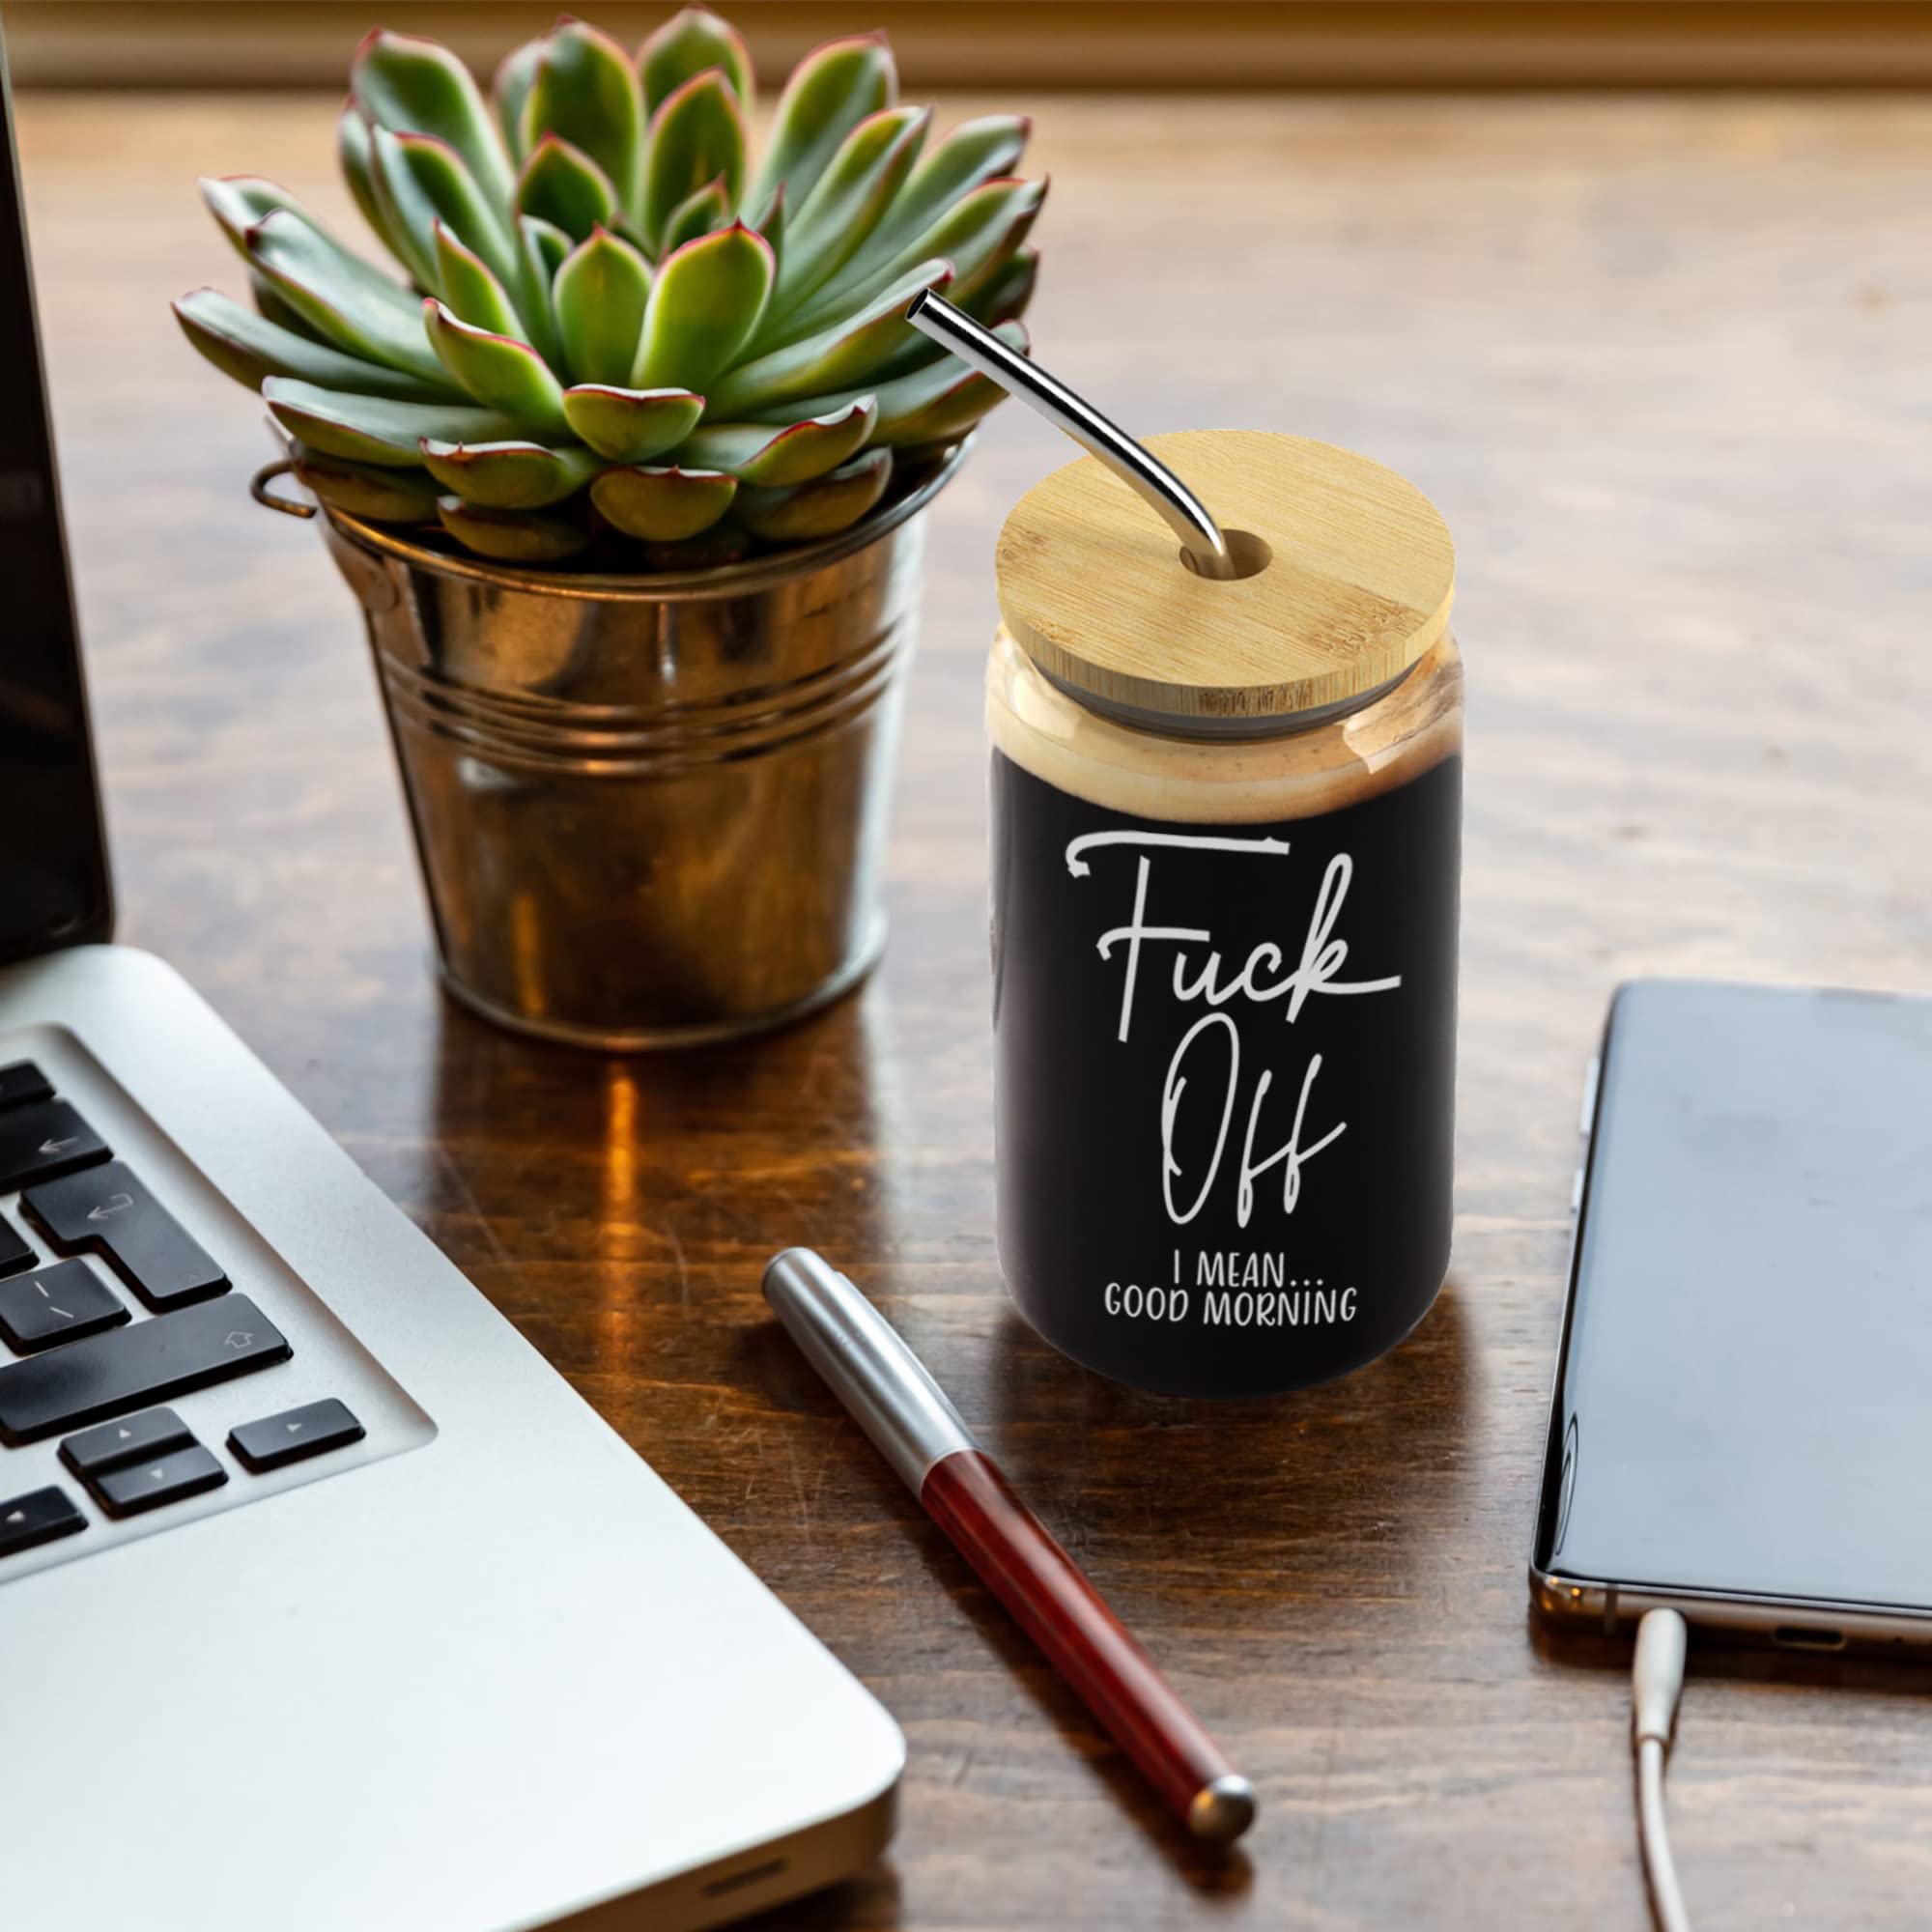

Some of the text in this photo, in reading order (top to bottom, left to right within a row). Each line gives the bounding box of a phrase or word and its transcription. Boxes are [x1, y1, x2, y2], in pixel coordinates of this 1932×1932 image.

[1065, 830, 1402, 1042] Fuck
[1161, 1011, 1347, 1229] Off
[1104, 1282, 1357, 1326] GOOD MORNING
[1173, 1249, 1324, 1288] I MEAN...
